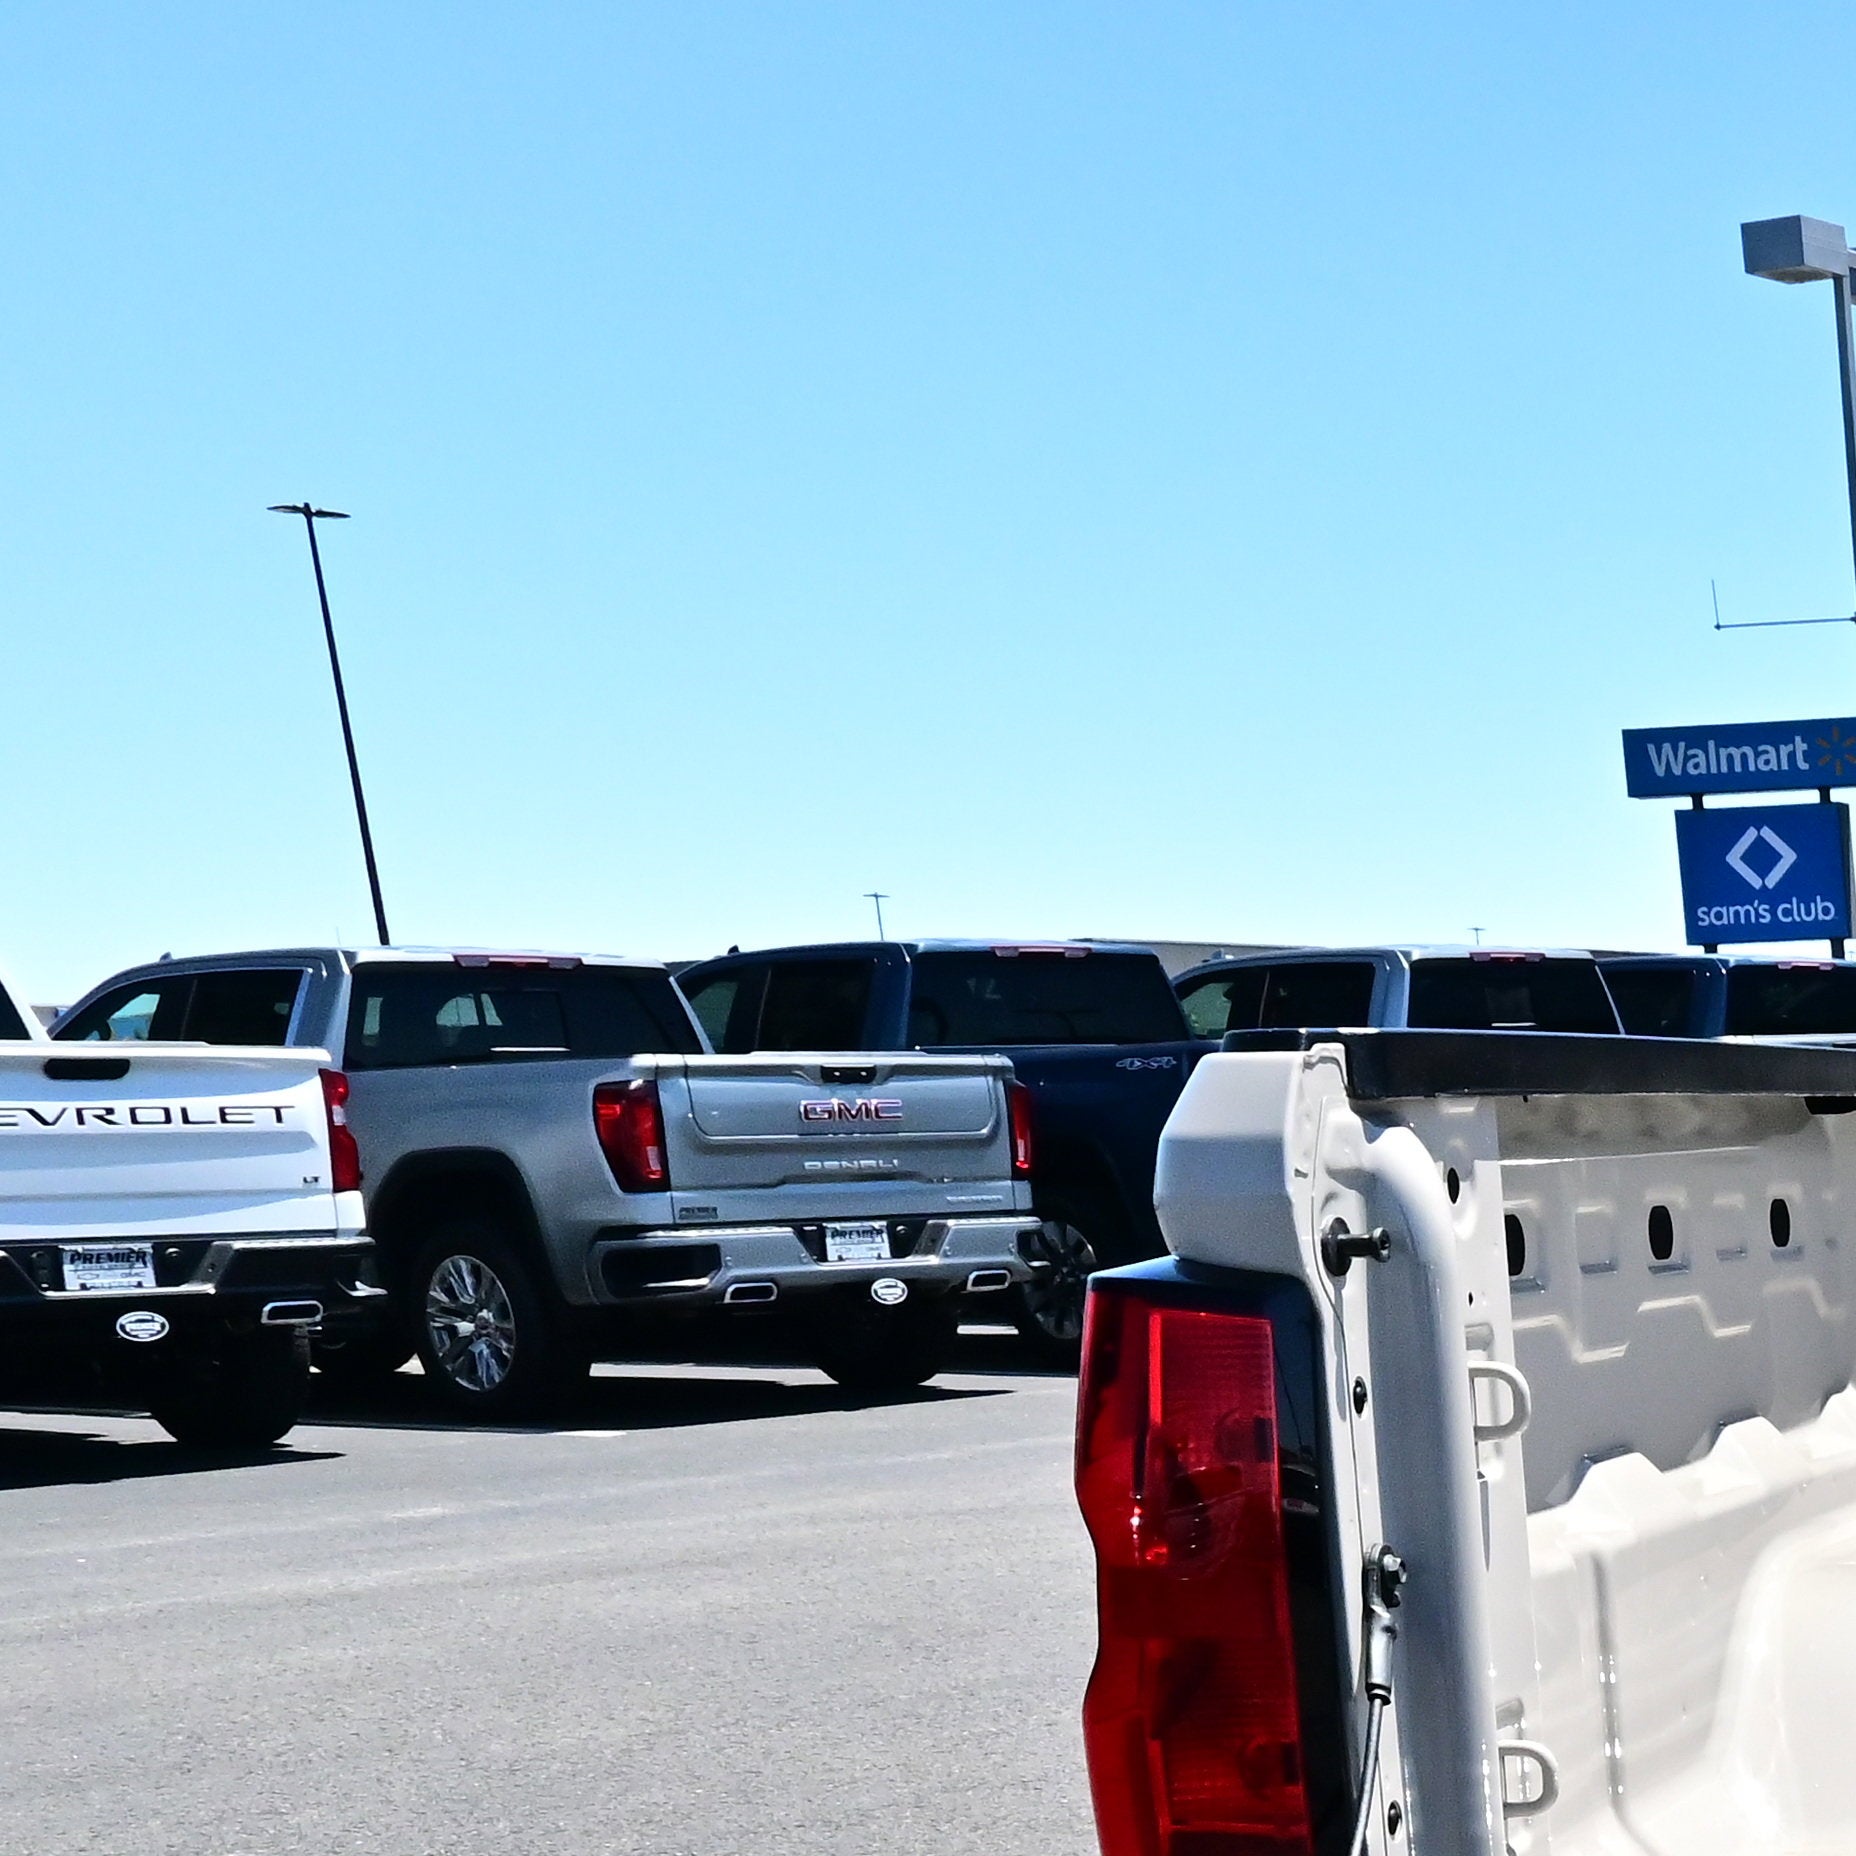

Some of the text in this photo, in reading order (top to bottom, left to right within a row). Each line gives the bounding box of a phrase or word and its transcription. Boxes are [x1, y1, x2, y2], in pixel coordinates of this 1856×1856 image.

[1646, 735, 1810, 777] Walmart
[1697, 896, 1836, 927] sam's club
[799, 1097, 904, 1122] GMC
[803, 1158, 899, 1170] DENALI
[302, 1176, 321, 1184] LT
[831, 1228, 885, 1243] PREMIER
[69, 1251, 148, 1268] PREMIER
